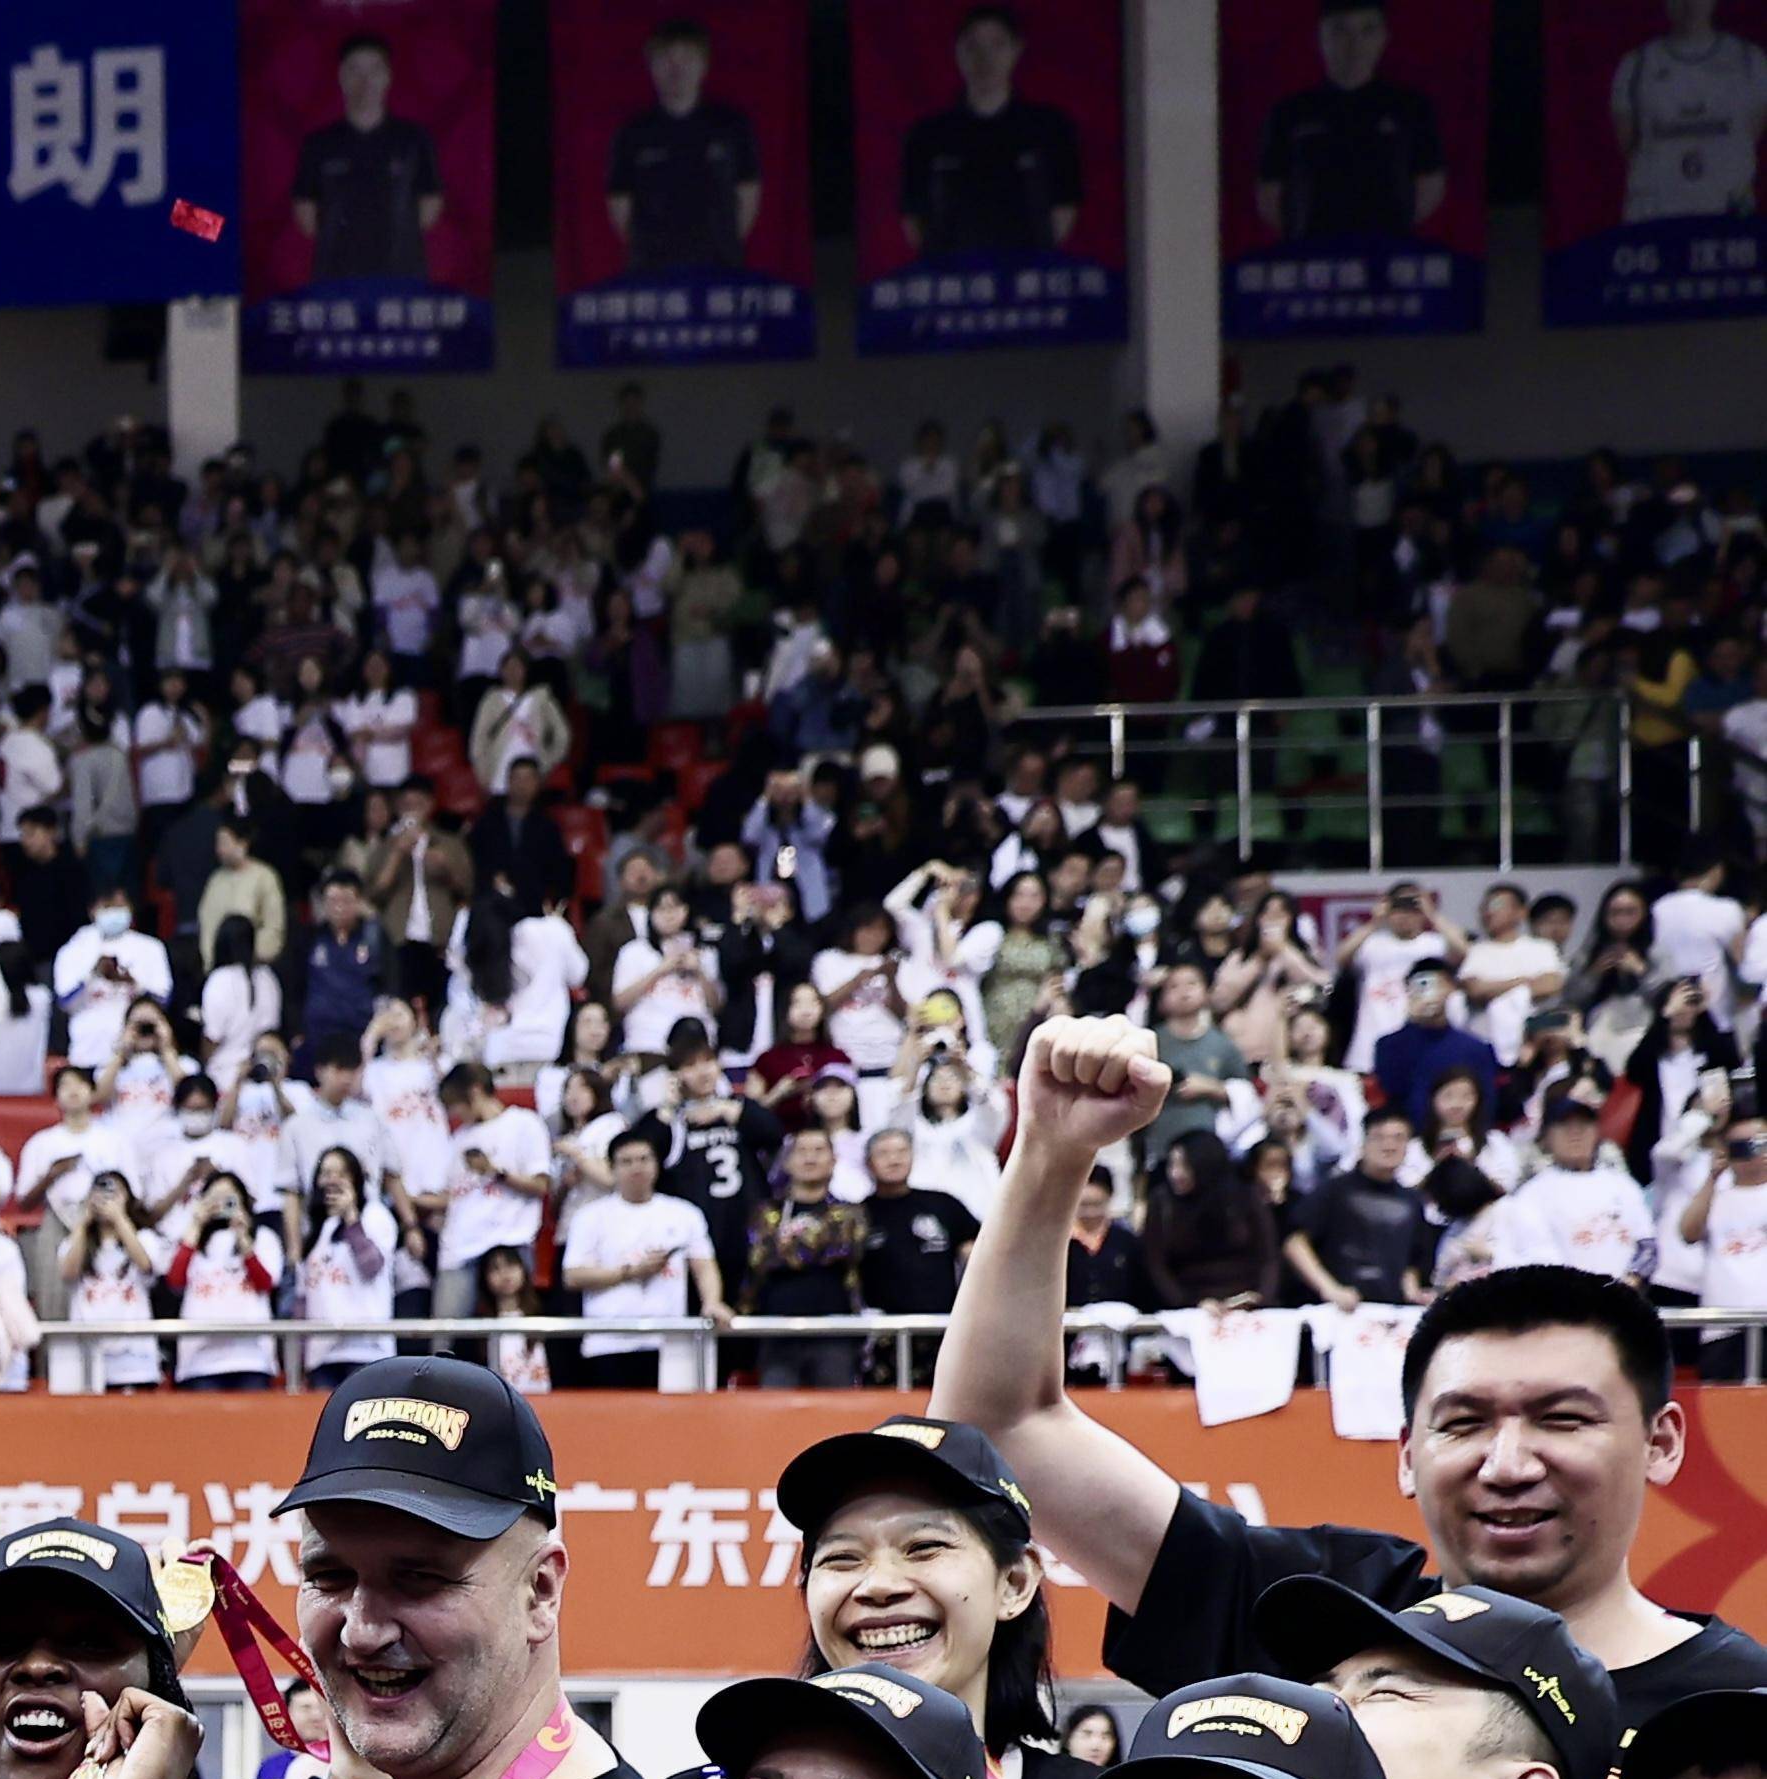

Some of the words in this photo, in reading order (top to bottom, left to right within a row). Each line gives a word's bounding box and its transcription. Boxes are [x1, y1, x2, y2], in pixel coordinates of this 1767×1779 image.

[705, 1144, 743, 1198] 3
[343, 1394, 471, 1452] CHAMPIONS
[364, 1429, 429, 1446] 2024-2025
[5, 1529, 118, 1572] CHAMPIONS
[1167, 1694, 1310, 1746] CHAMPIONS
